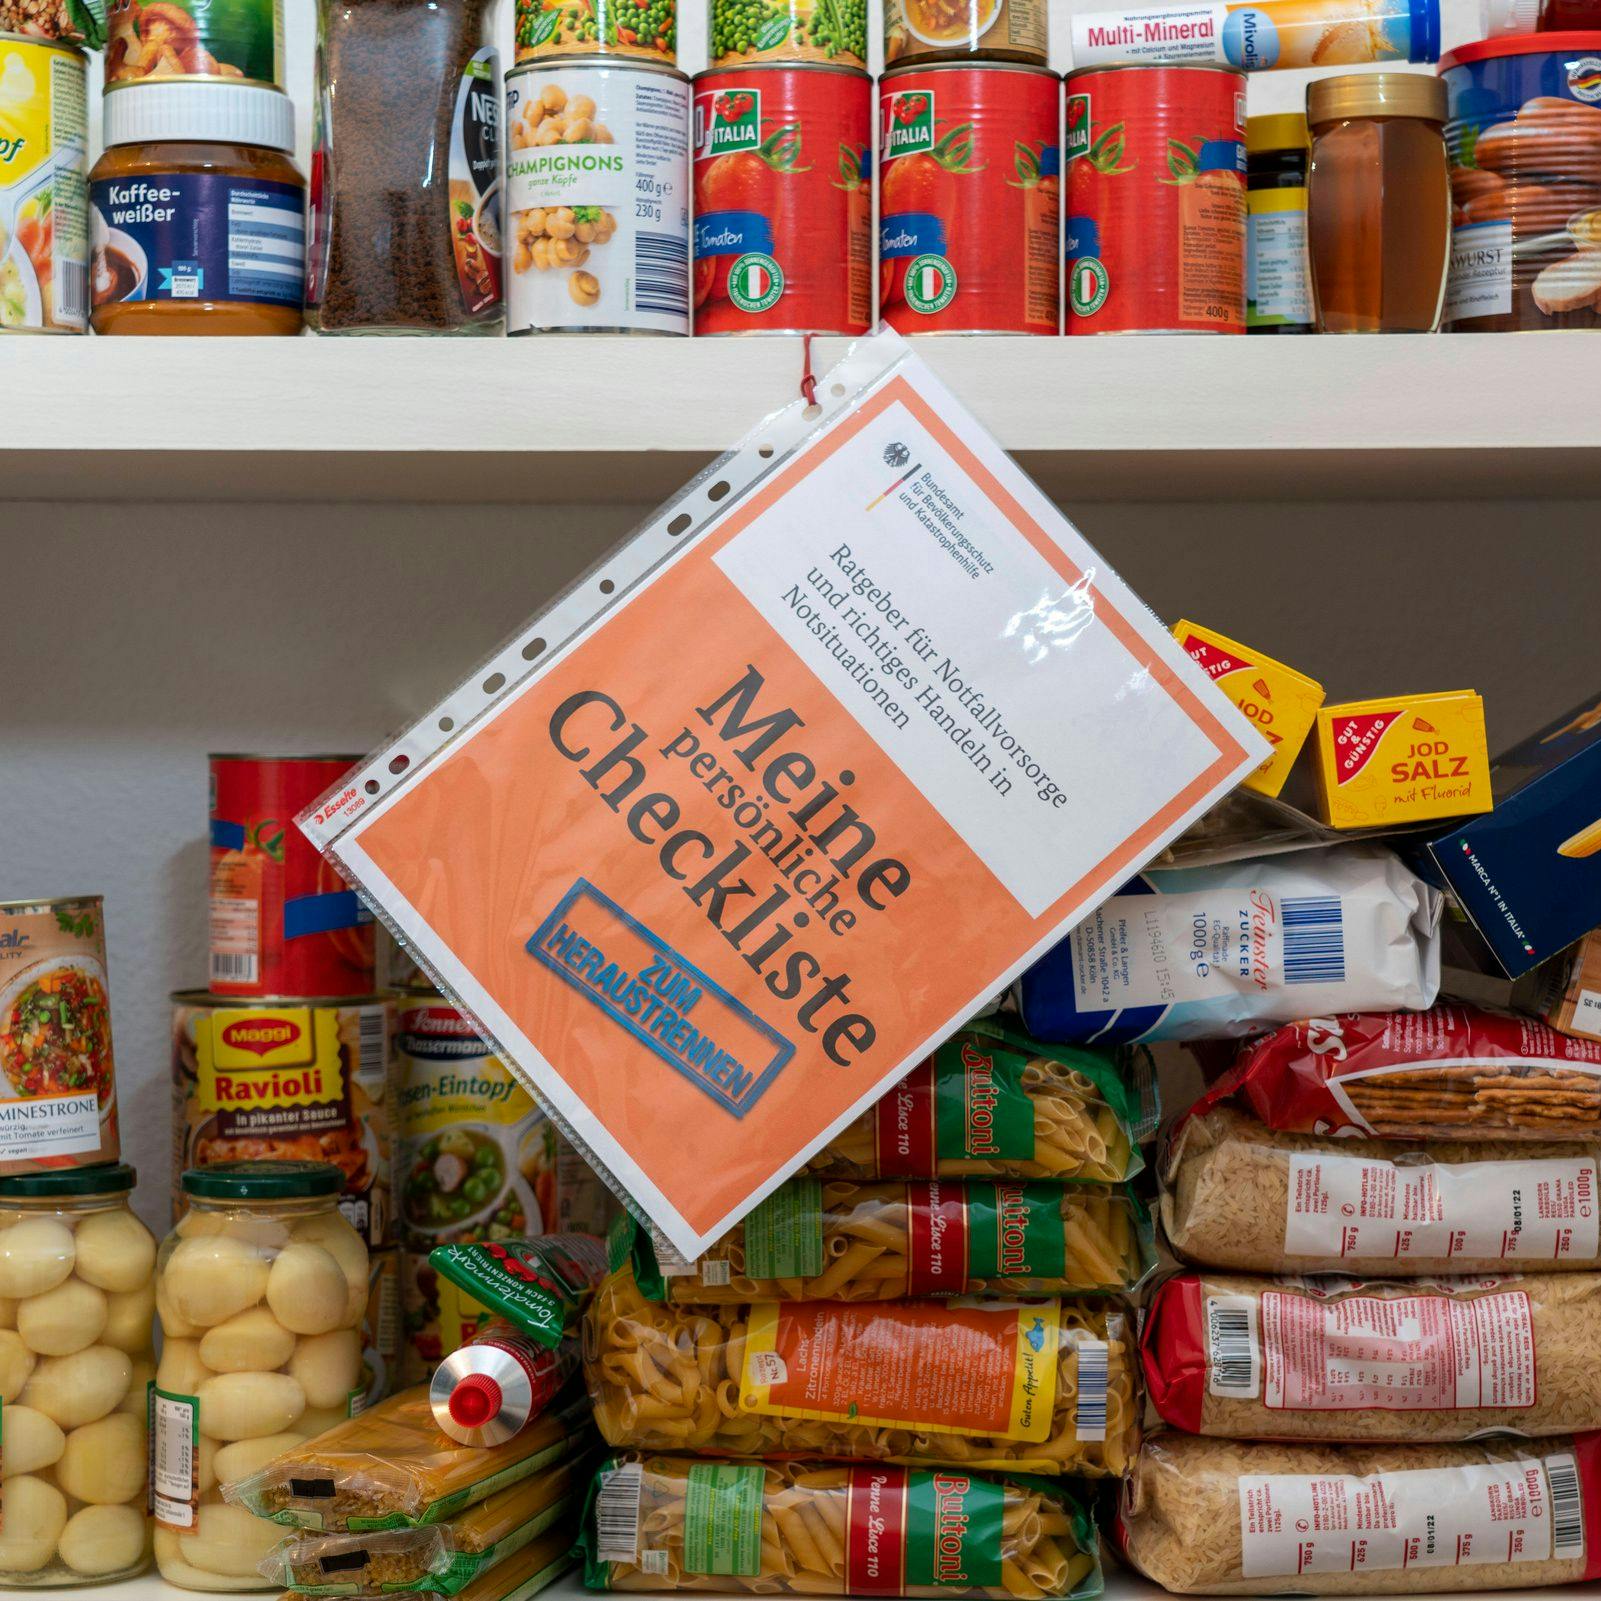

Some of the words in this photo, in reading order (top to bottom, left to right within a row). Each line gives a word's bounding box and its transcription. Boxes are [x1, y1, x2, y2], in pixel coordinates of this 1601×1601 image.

[1087, 18, 1214, 47] Multi-Mineral
[471, 91, 500, 126] NES
[507, 155, 624, 178] CHAMPIGNONS
[109, 183, 181, 205] Kaffee-
[635, 179, 655, 193] 400
[655, 183, 662, 197] g
[112, 205, 176, 224] weißer
[635, 203, 654, 218] 230
[655, 208, 662, 222] g
[701, 225, 743, 248] Tomaten
[1206, 305, 1230, 321] 400g
[920, 472, 965, 520] Bundesamt
[899, 492, 917, 511] und
[914, 507, 980, 580] Katastrophenhilfe
[910, 481, 925, 497] für
[921, 494, 994, 574] Bevölkerungsschutz
[781, 583, 911, 731] Notsituationen
[1190, 646, 1208, 660] UT
[806, 566, 849, 610] und
[841, 607, 919, 690] richtiges
[914, 685, 992, 774] Handeln
[988, 766, 1013, 798] in
[829, 543, 911, 631] Ratgeber
[904, 627, 938, 663] für
[932, 657, 1068, 809] Notfallvorsorge
[1337, 720, 1359, 745] GUT
[1344, 719, 1385, 770] GÜNSTIG
[1350, 734, 1362, 745] &
[1407, 741, 1450, 759] JOD
[1391, 756, 1470, 784] SALZ
[695, 663, 911, 911] Meine
[1394, 788, 1416, 804] mit
[1420, 782, 1472, 801] Fluorid
[323, 788, 357, 819] Esselte
[658, 727, 857, 937] persönliche
[548, 689, 877, 1067] Checkliste
[1468, 854, 1491, 887] MARCA
[1497, 901, 1508, 913] IN
[1110, 926, 1118, 949] GmbH
[1193, 911, 1208, 948] 1000
[1239, 909, 1250, 977] ZUCKER
[1251, 889, 1276, 992] Feinster
[1098, 945, 1108, 973] Straße
[1120, 955, 1130, 986] Langen
[1190, 950, 1204, 961] g
[638, 953, 703, 1015] ZUM
[1089, 965, 1097, 984] Köln
[546, 923, 754, 1098] HERAUSTRENNEN
[214, 1069, 323, 1103] Ravioli
[0, 1099, 96, 1120] MINESTRONE
[898, 1092, 914, 1131] Lisce
[14, 1130, 45, 1139] Tomate
[47, 1125, 84, 1136] verfeinert
[898, 1133, 910, 1156] 110
[1360, 1168, 1369, 1217] INFO-HOTLINE
[1577, 1168, 1592, 1205] 1000g
[930, 1213, 947, 1251] Lisce
[1347, 1234, 1357, 1251] 750
[1401, 1237, 1410, 1252] 625
[1454, 1238, 1464, 1252] 500
[1507, 1237, 1517, 1252] 375
[1561, 1236, 1570, 1252] 250
[467, 1246, 525, 1292] KONZENTRIERT
[930, 1252, 943, 1275] 110
[447, 1244, 556, 1329] Tomatenmark
[1210, 1312, 1221, 1347] 006237
[765, 1353, 777, 1367] 57
[805, 1310, 826, 1400] Zitronennudeln
[1021, 1351, 1038, 1397] Appetit!
[1020, 1398, 1034, 1429] Guten
[869, 1475, 887, 1513] Penne
[1264, 1483, 1272, 1517] Portionen
[1370, 1482, 1380, 1519] consumarsi
[1525, 1468, 1542, 1504] 1000g
[1256, 1498, 1265, 1534] entspricht
[1311, 1481, 1321, 1531] INFO-HOTLINE
[1355, 1492, 1364, 1530] Mindestens
[1364, 1506, 1372, 1530] haltbar
[1487, 1485, 1497, 1521] LANGKORN
[1513, 1496, 1521, 1520] LUNGA
[867, 1515, 885, 1554] Lisce
[933, 1472, 970, 1582] Buitoni
[1266, 1517, 1274, 1534] zwei
[1373, 1519, 1381, 1530] Da
[1389, 1510, 1397, 1529] entro
[1304, 1550, 1313, 1566] 750
[1356, 1548, 1366, 1564] 625
[1409, 1545, 1418, 1560] 500
[1462, 1541, 1471, 1557] 375
[1513, 1537, 1523, 1553] 250
[867, 1556, 879, 1578] 110
